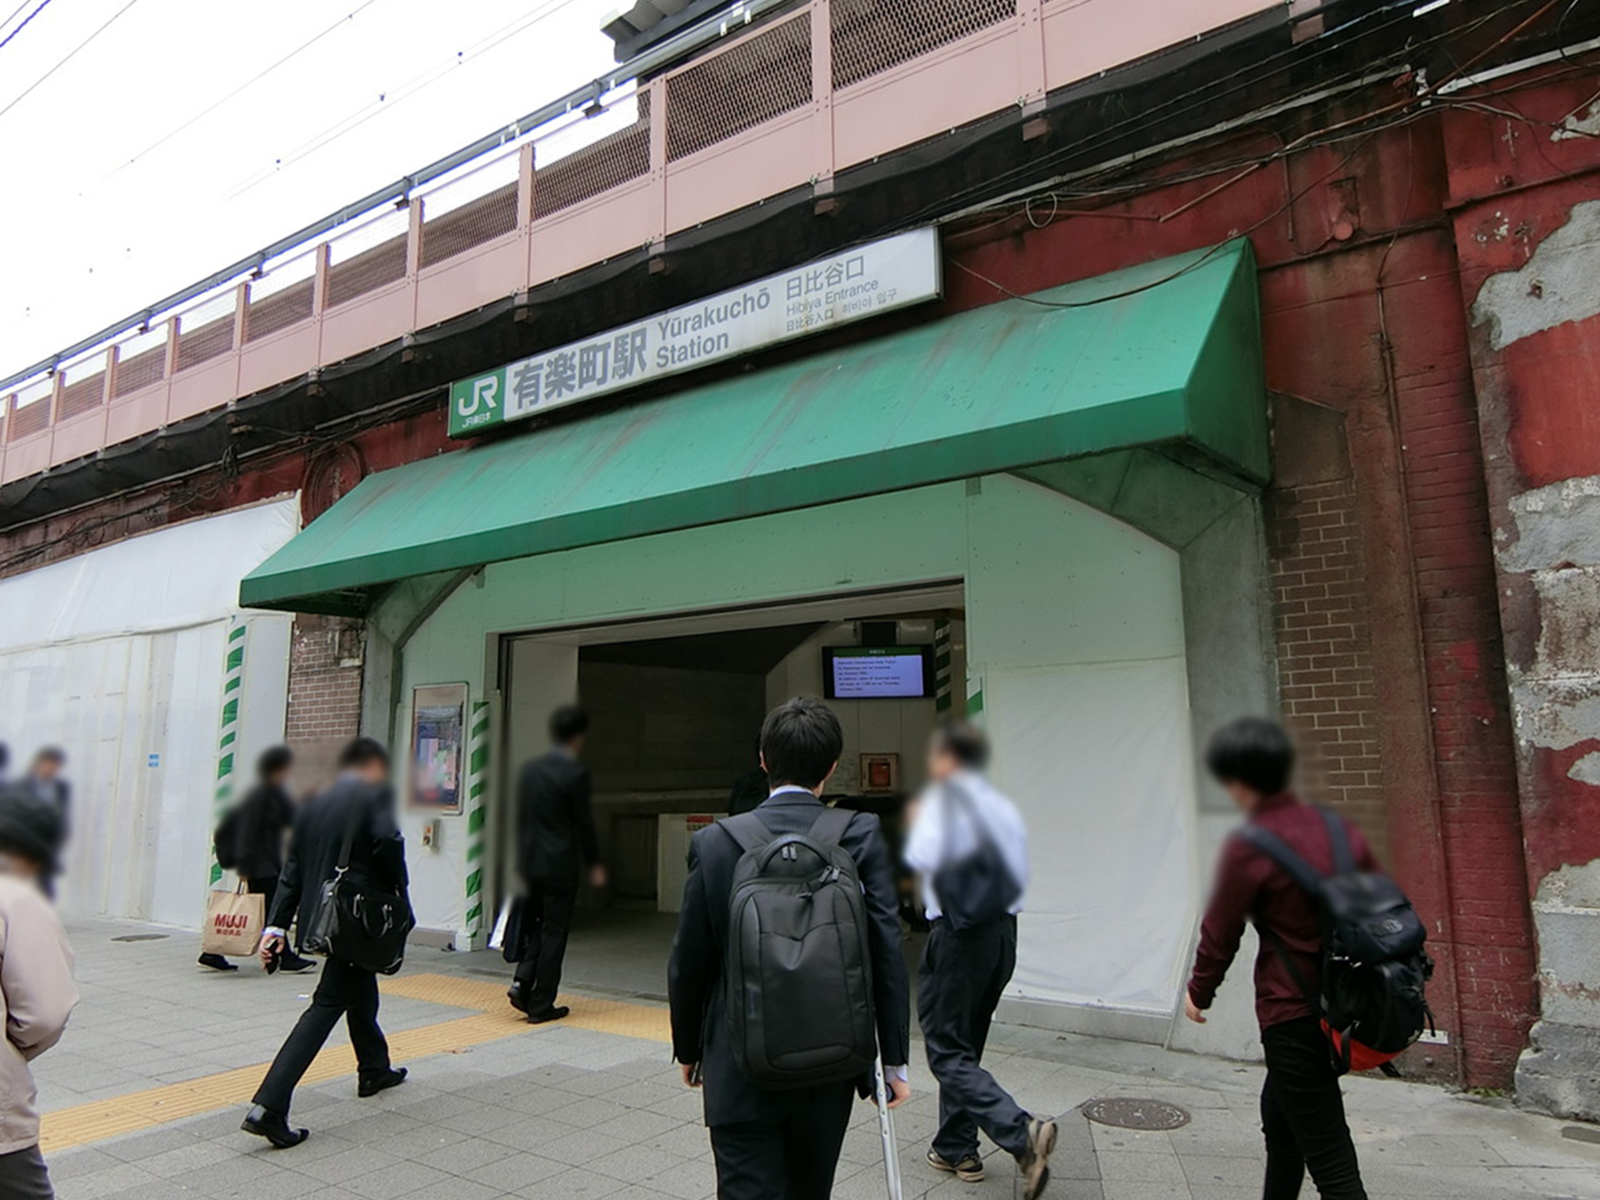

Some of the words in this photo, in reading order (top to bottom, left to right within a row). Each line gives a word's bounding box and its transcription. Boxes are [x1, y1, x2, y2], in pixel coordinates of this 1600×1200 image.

[786, 256, 864, 301] 日比谷口
[786, 297, 822, 317] Hibiya
[825, 279, 879, 305] Entrance
[658, 287, 770, 341] Yūrakuchō
[512, 327, 647, 410] 有楽町駅
[656, 332, 729, 368] Station
[457, 375, 498, 417] JR
[214, 913, 248, 929] MUJI
